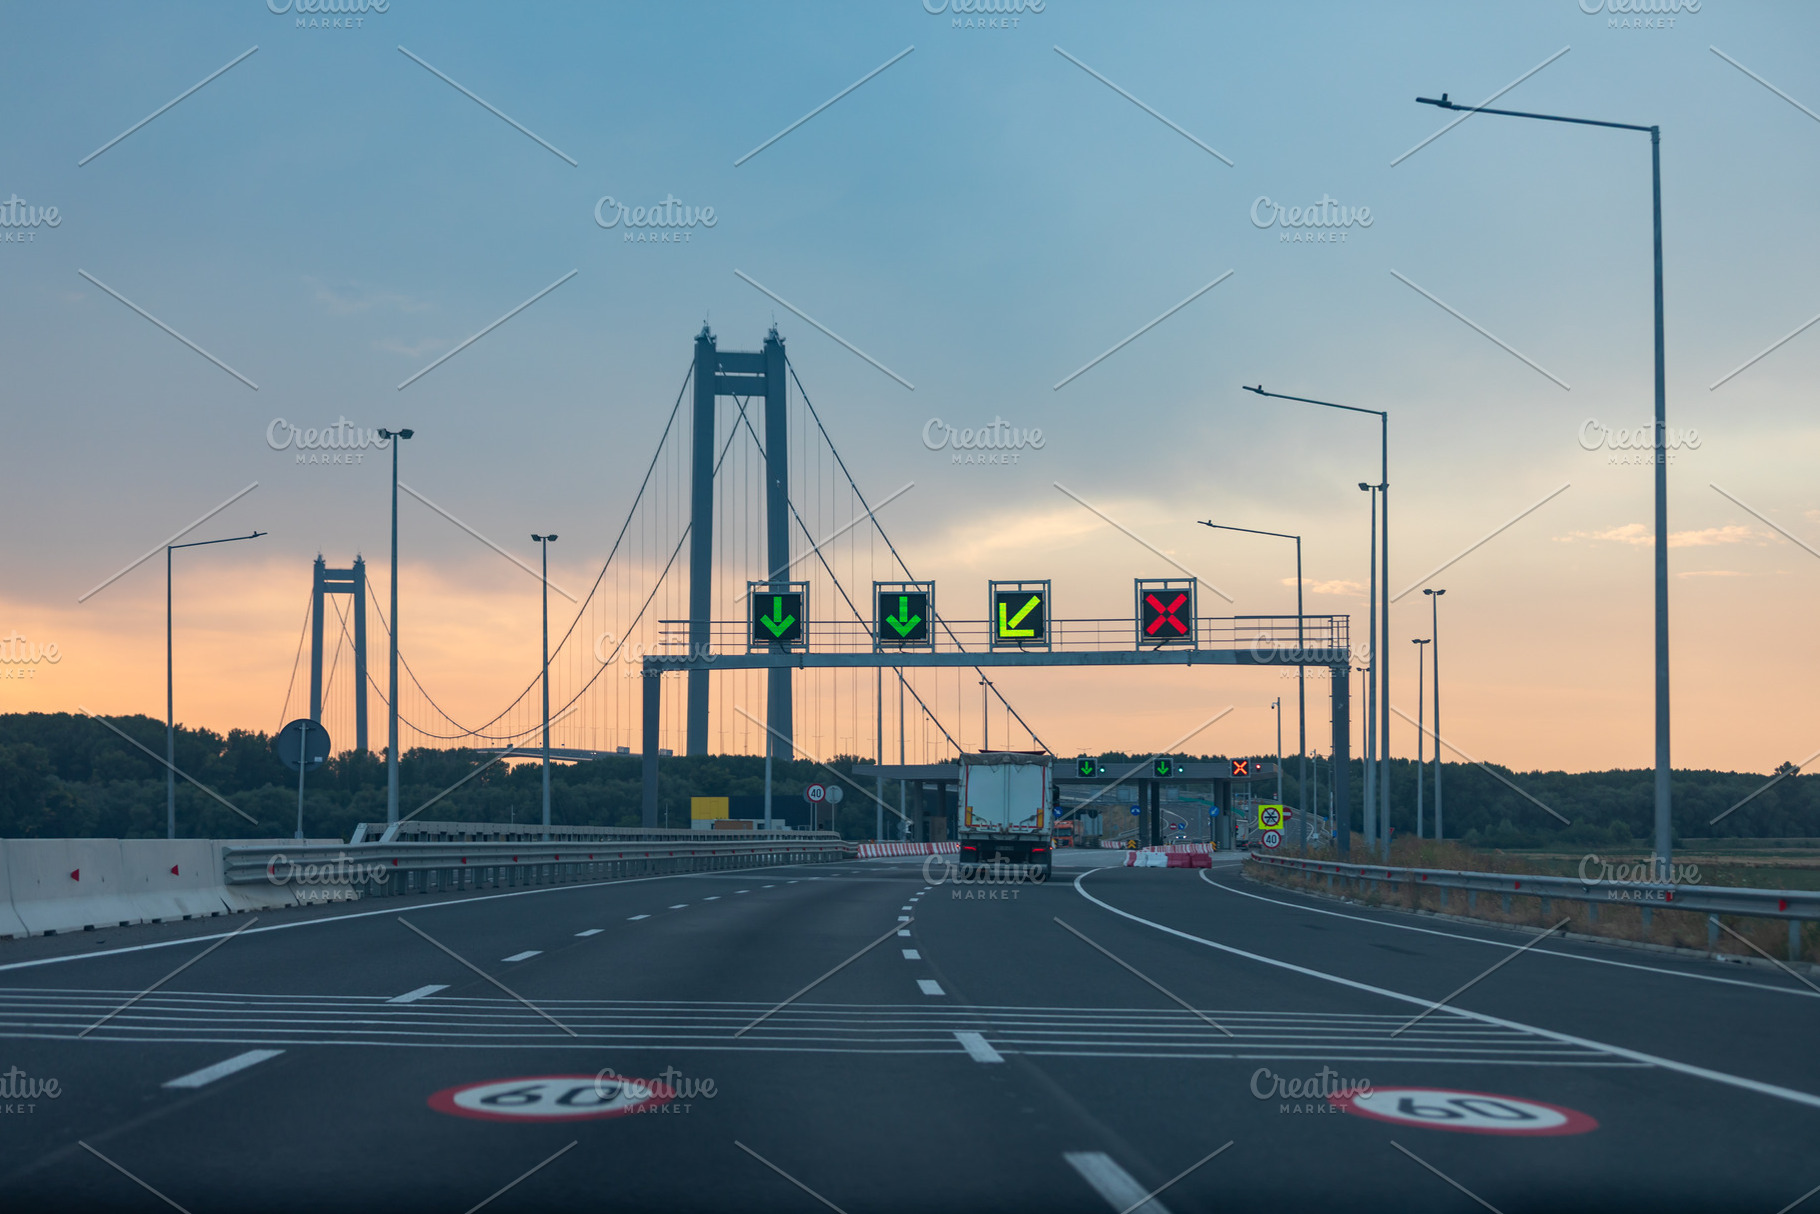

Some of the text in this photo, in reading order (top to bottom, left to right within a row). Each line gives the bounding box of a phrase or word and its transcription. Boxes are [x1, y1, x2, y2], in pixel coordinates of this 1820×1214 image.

[810, 788, 822, 798] 40
[1265, 834, 1277, 844] 40
[480, 1083, 622, 1108] 60
[1397, 1097, 1539, 1121] 60
